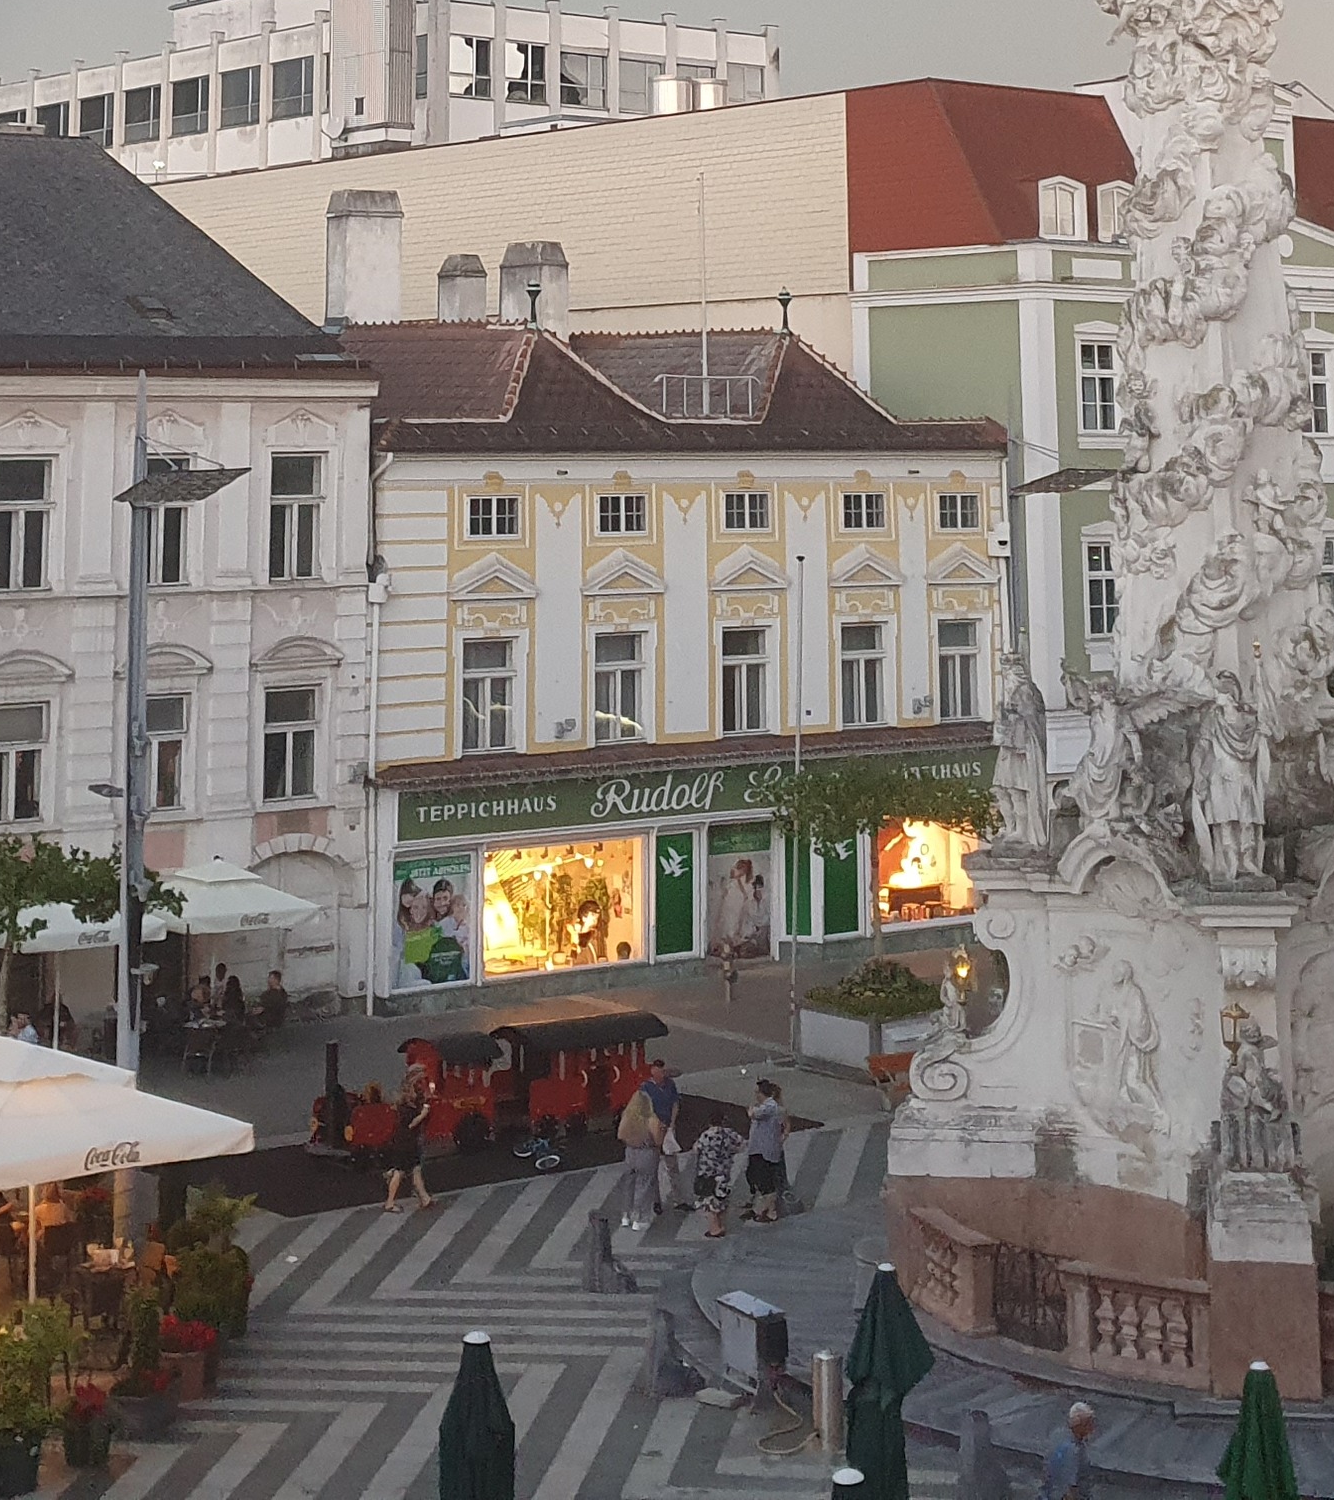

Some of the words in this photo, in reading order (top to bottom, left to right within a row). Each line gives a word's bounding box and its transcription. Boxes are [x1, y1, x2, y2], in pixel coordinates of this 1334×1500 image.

[893, 761, 982, 780] LHAUS
[590, 770, 724, 818] Rudolf
[417, 795, 557, 823] TEPPICHHAUS
